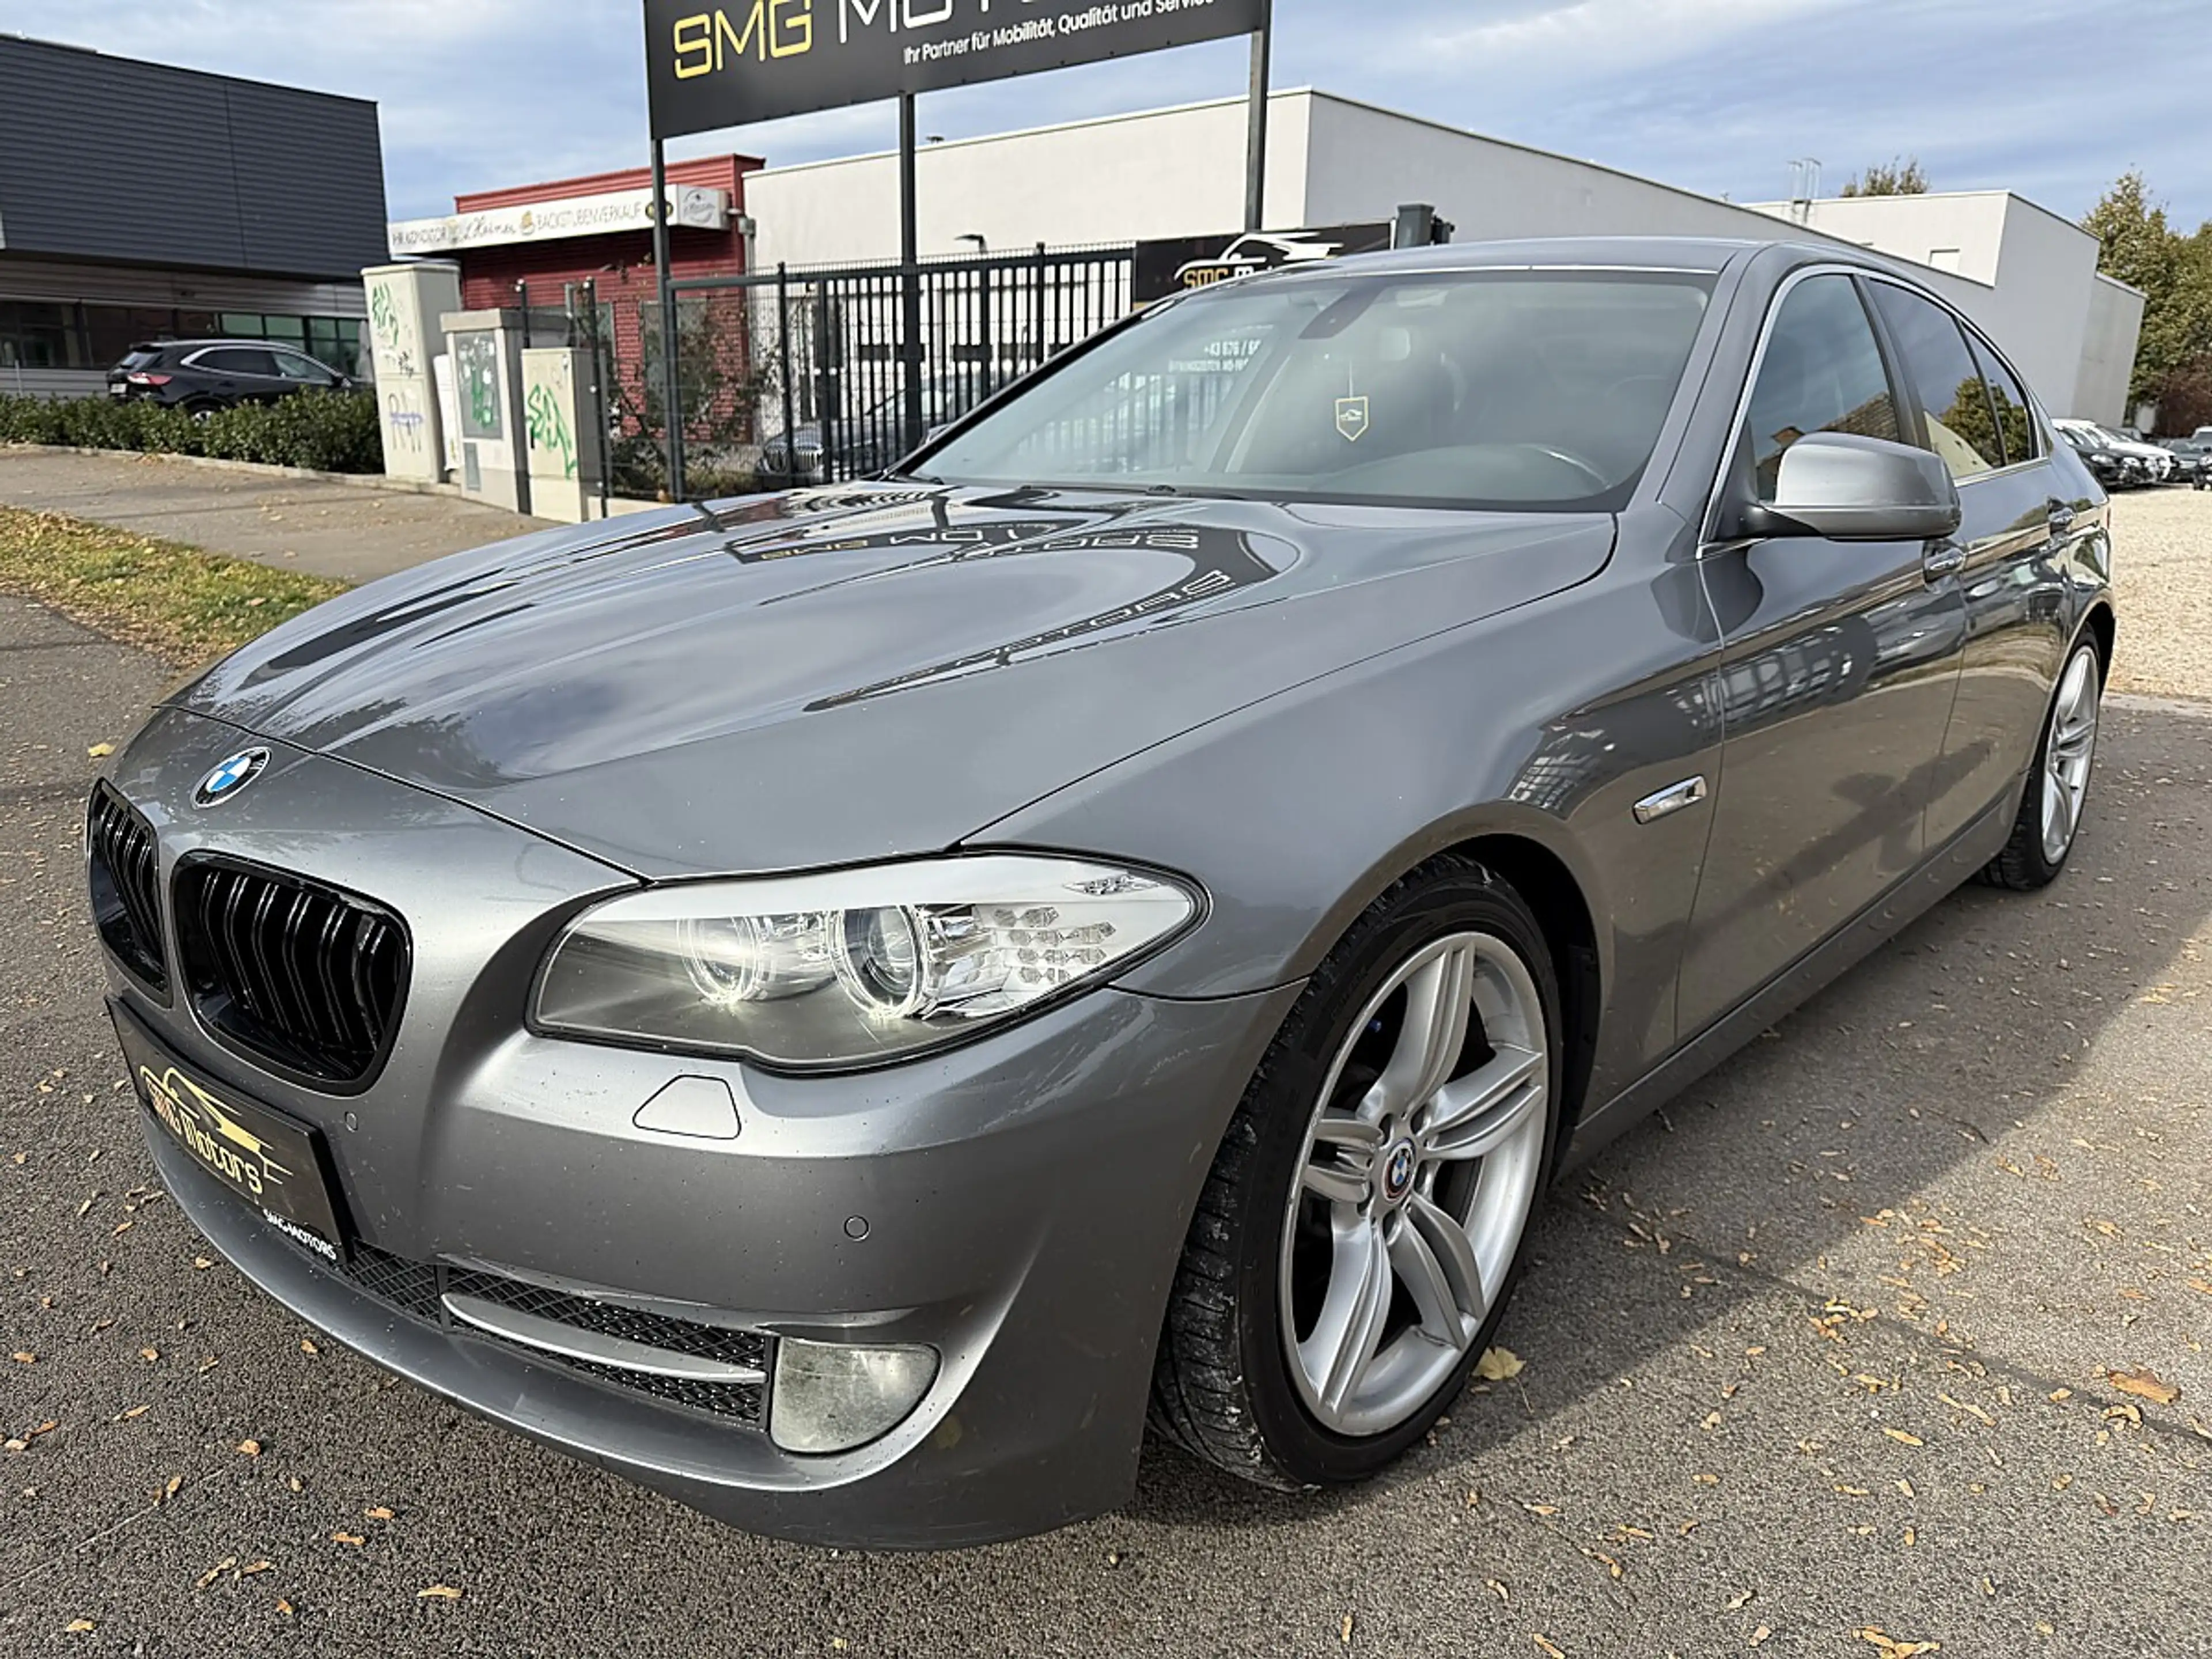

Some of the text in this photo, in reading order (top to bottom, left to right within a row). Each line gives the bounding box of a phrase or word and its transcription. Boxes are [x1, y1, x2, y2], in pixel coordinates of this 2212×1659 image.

[673, 0, 813, 79] SMG
[903, 46, 921, 65] Ihr
[922, 39, 970, 62] Partner
[971, 31, 991, 51] für
[993, 17, 1056, 47] Mobilität,
[1058, 3, 1119, 36] Qualität
[1120, 0, 1152, 21] und
